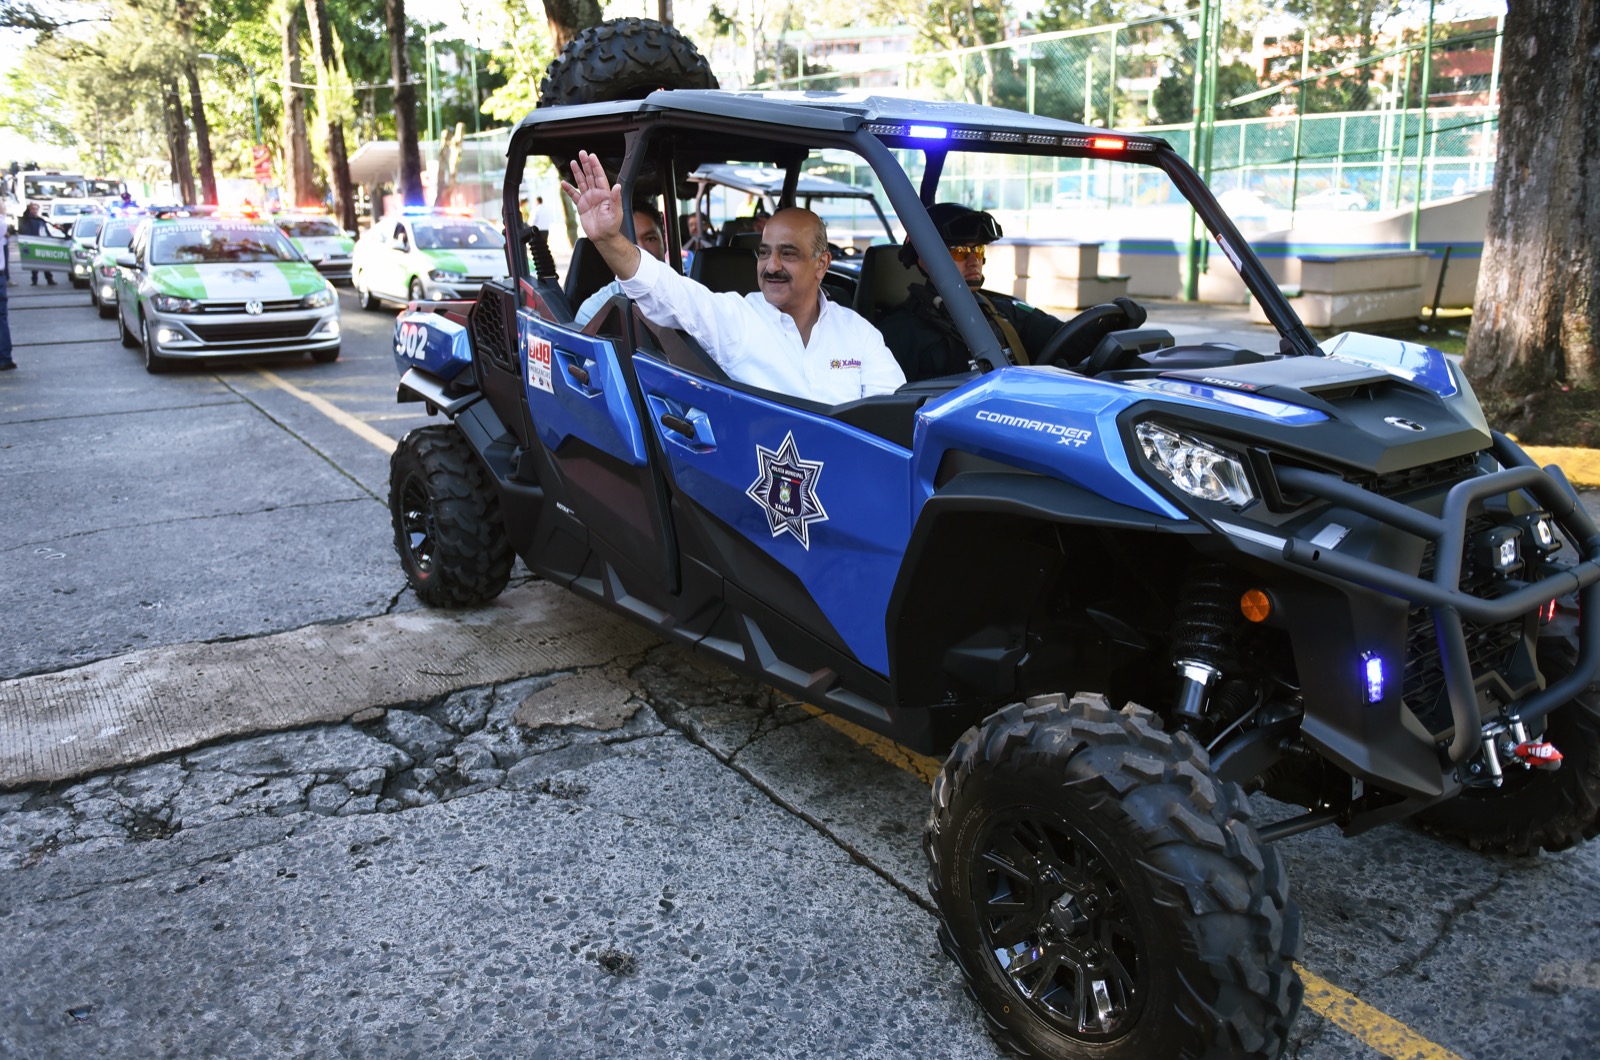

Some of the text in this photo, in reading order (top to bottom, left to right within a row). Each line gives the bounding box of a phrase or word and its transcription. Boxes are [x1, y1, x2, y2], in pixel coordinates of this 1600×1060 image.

[397, 322, 428, 361] 902
[528, 341, 551, 365] 911
[975, 410, 1092, 440] COMMANDER
[1057, 436, 1087, 448] XT
[774, 502, 795, 515] XALAPA
